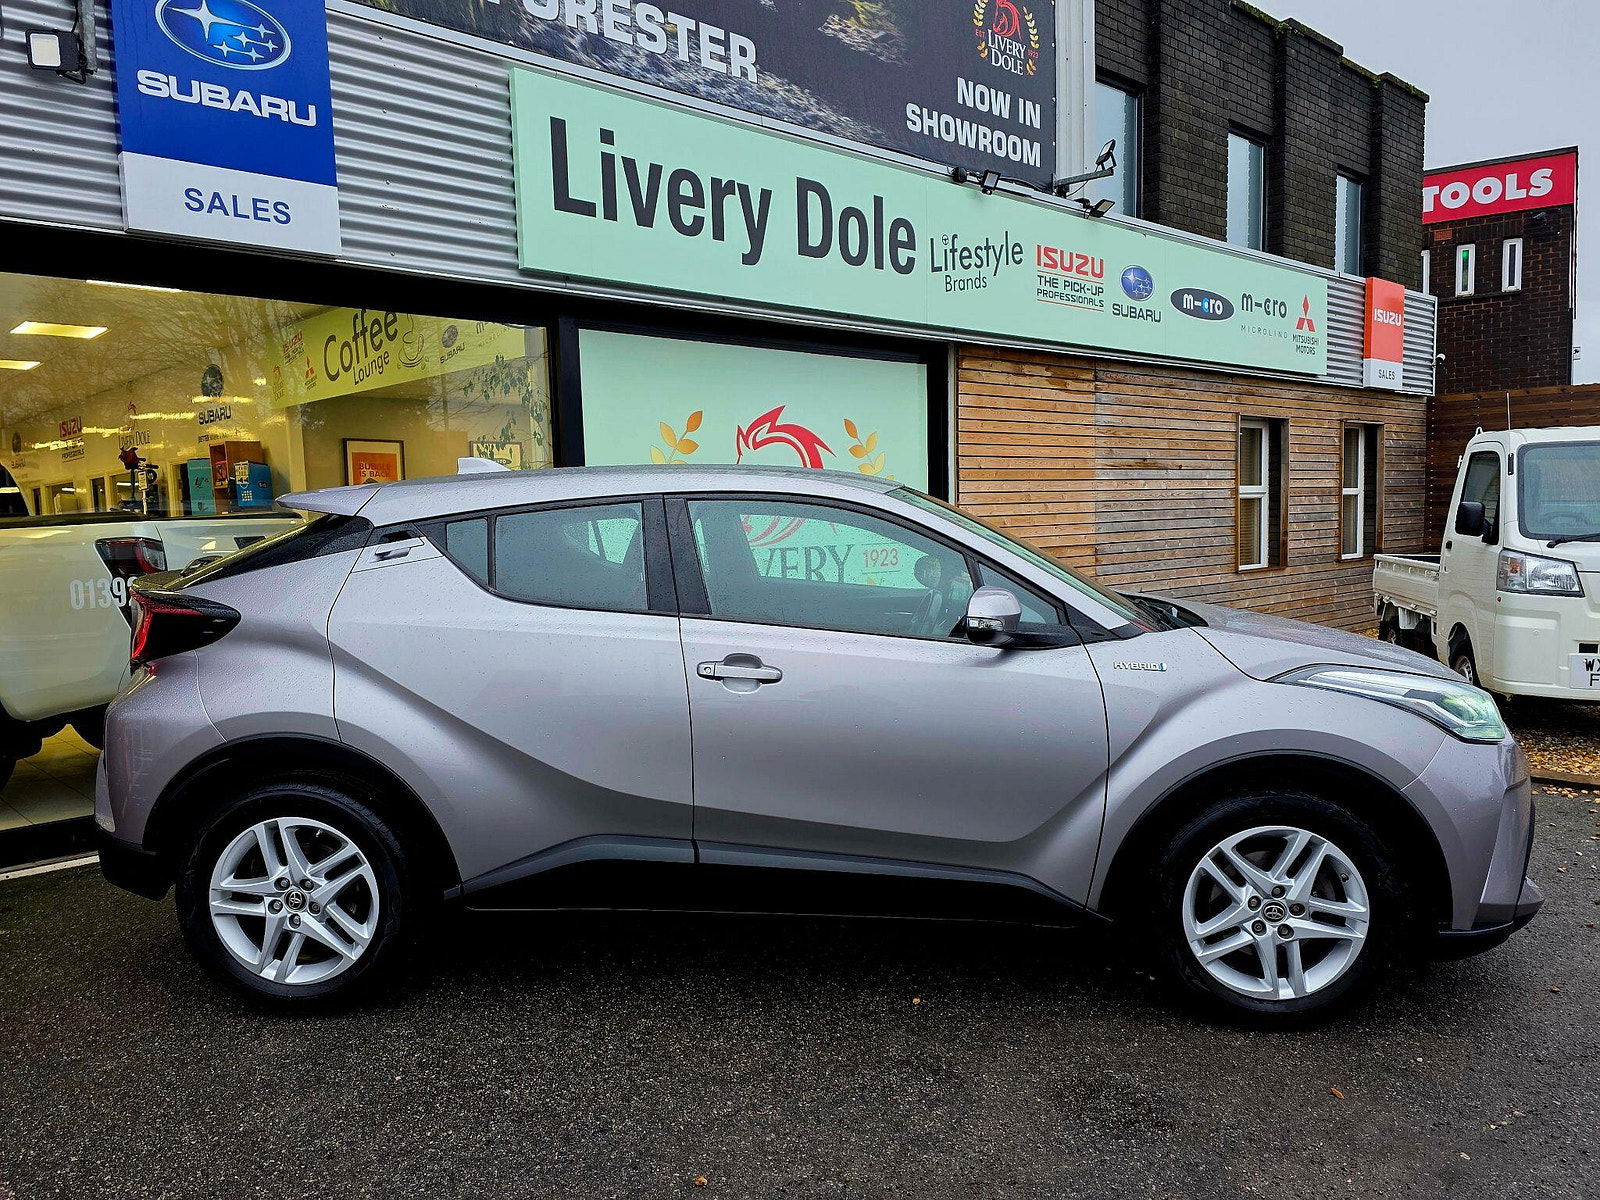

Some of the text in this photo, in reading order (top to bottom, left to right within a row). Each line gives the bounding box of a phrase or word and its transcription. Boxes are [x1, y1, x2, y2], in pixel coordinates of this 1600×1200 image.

[987, 29, 1026, 59] LIVERY
[991, 48, 1023, 75] DOLE
[137, 69, 317, 127] SUBARU
[957, 77, 1041, 129] NOW IN
[905, 103, 1041, 168] SHOWROOM
[550, 116, 916, 275] Livery Dole
[1423, 168, 1553, 212] TOOLS
[184, 187, 292, 225] SALES
[929, 230, 1024, 276] Lifestyle
[1036, 244, 1104, 279] ISUZU
[945, 271, 987, 292] Brands
[1037, 274, 1104, 297] THE PICK-UP
[1036, 288, 1104, 308] PROFESSIONALS
[1112, 302, 1161, 323] SUBARU
[1374, 308, 1402, 326] ISUZU
[1240, 324, 1288, 339] MICROLINO
[1292, 334, 1320, 346] MITSUBISHI
[323, 308, 398, 382] Coffee
[440, 342, 466, 364] SUBARU
[1295, 344, 1316, 356] MOTORS
[352, 350, 390, 385] Lounge
[1378, 369, 1396, 381] SALES
[198, 405, 232, 425] SUBARU
[59, 416, 82, 438] ISUZU
[863, 548, 899, 568] 1923
[1113, 661, 1160, 671] HYBRID
